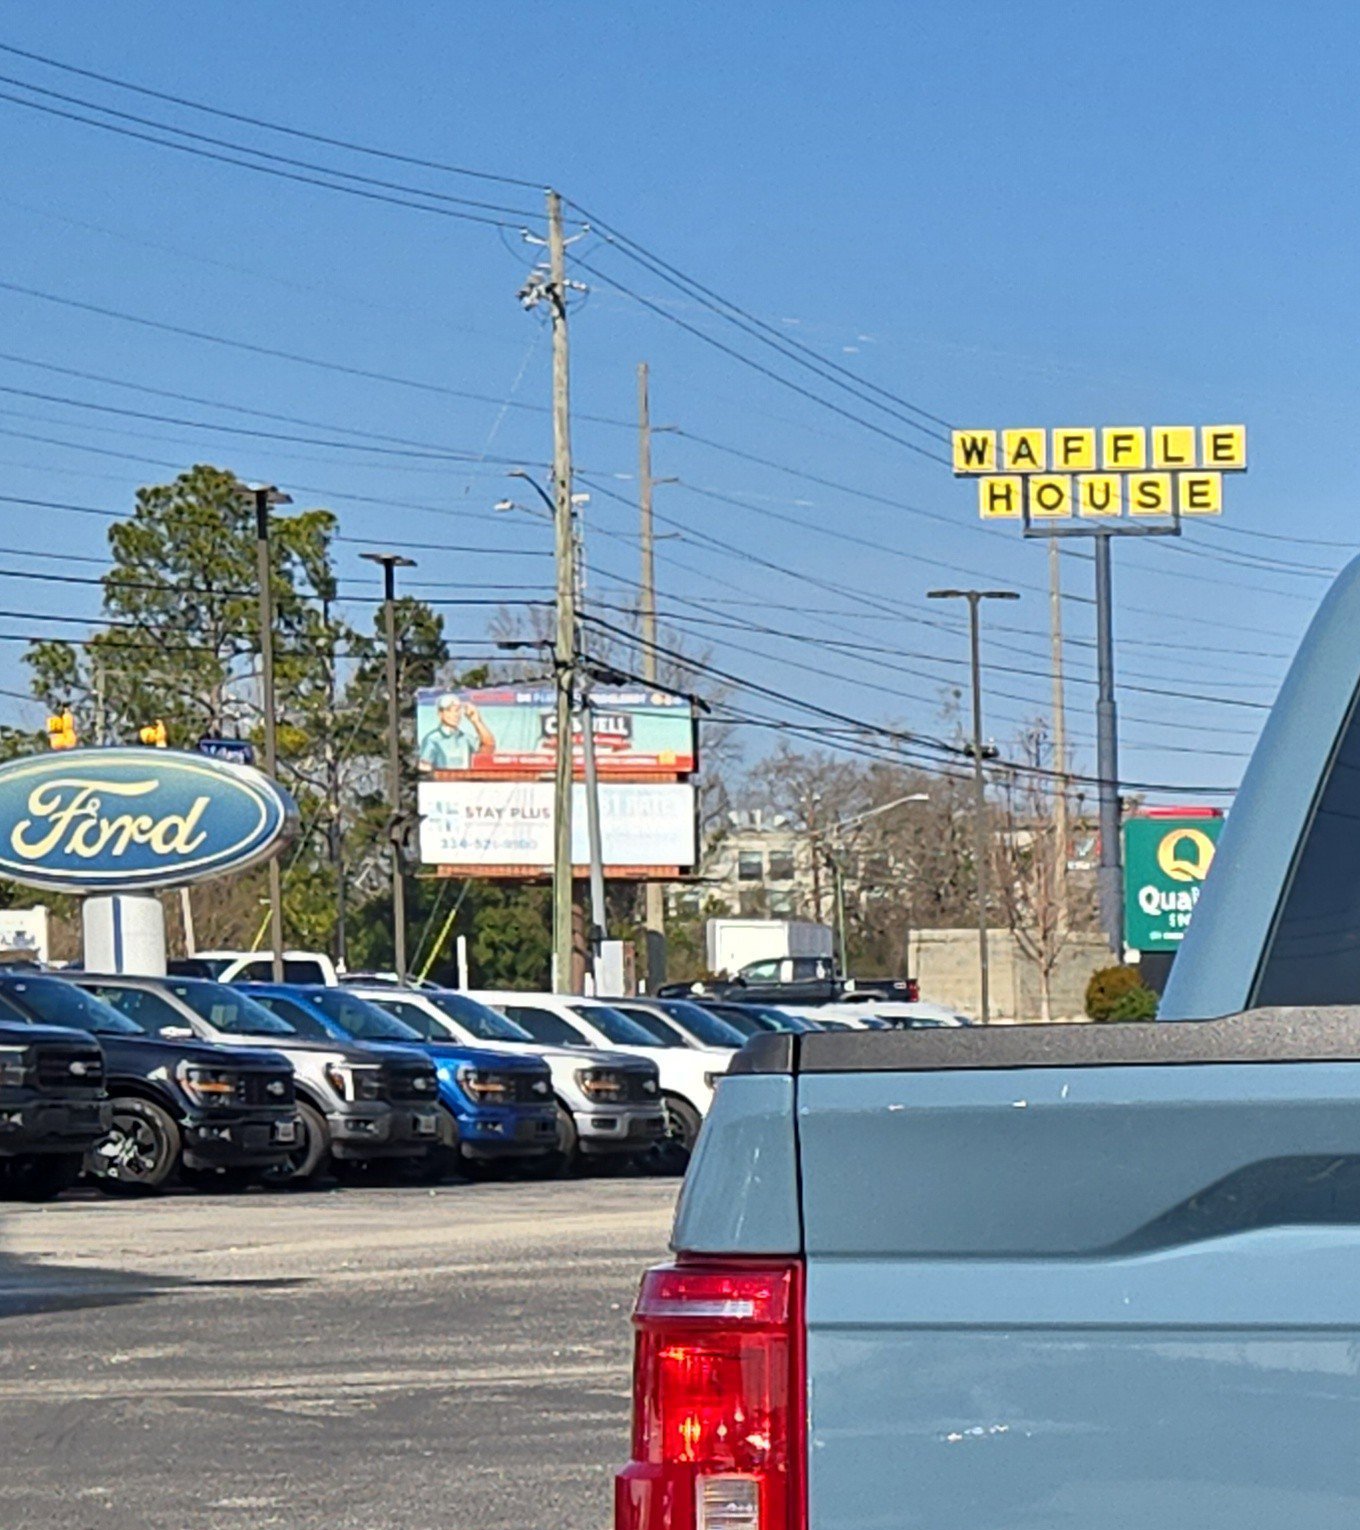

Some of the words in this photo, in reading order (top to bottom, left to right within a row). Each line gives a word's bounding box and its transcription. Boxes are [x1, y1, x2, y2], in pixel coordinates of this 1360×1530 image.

[960, 432, 1235, 465] WAFFLE
[988, 480, 1211, 511] HOUSE
[11, 779, 210, 859] Ford
[465, 806, 503, 819] STAY
[510, 805, 551, 819] PLUS
